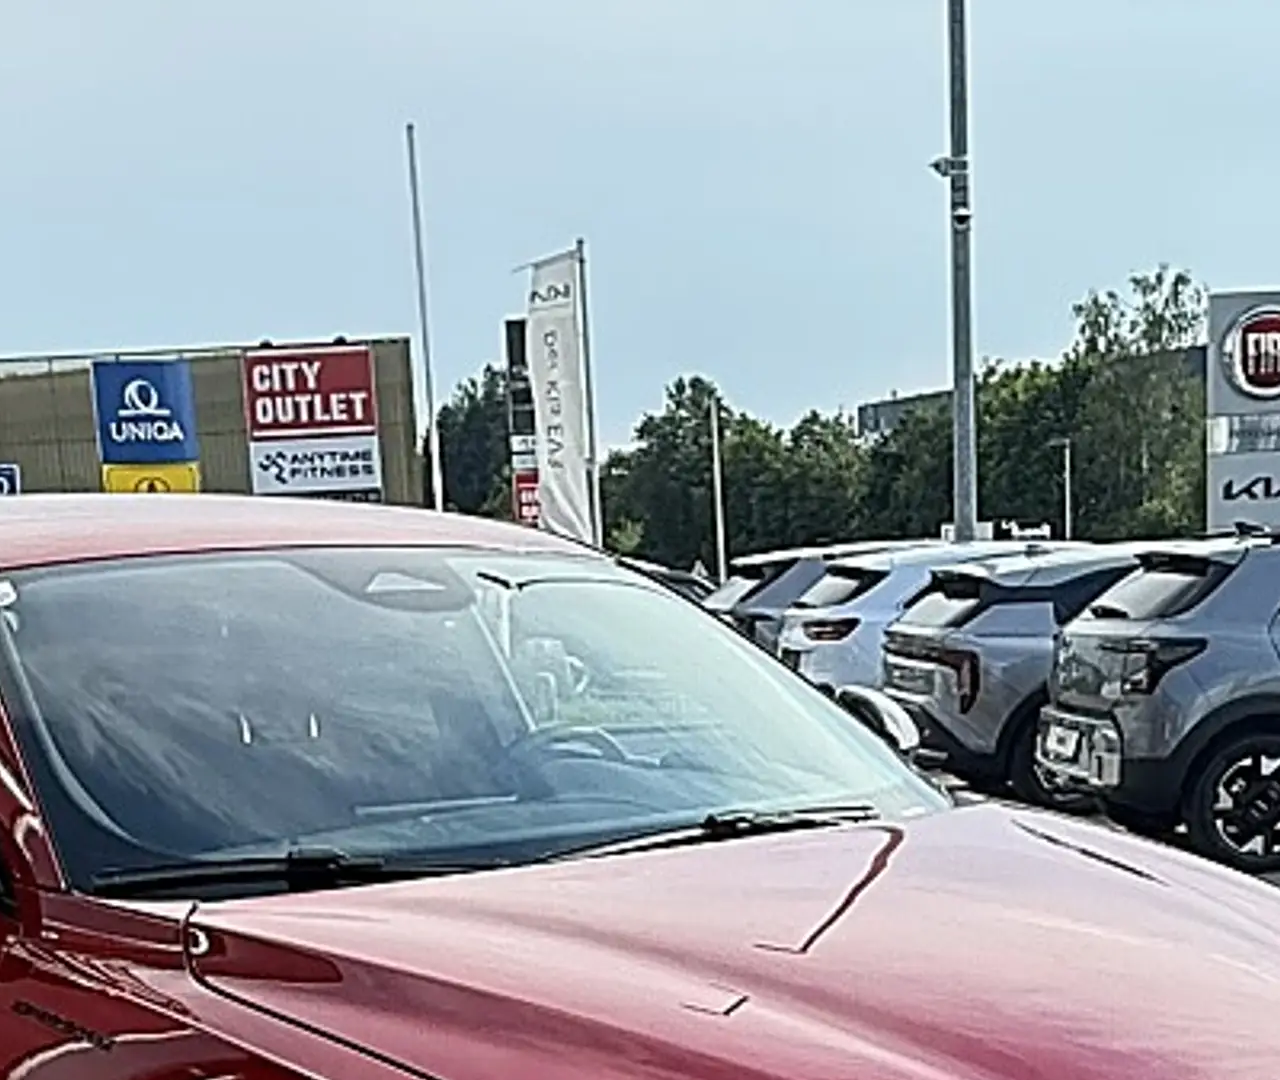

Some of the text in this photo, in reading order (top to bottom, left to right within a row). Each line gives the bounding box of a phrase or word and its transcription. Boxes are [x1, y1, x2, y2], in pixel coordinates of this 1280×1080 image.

[252, 361, 321, 391] CITY
[255, 392, 369, 424] OUTLET
[110, 421, 184, 442] UNIQA
[291, 450, 373, 465] ANYTIME
[291, 464, 375, 479] FITNESS
